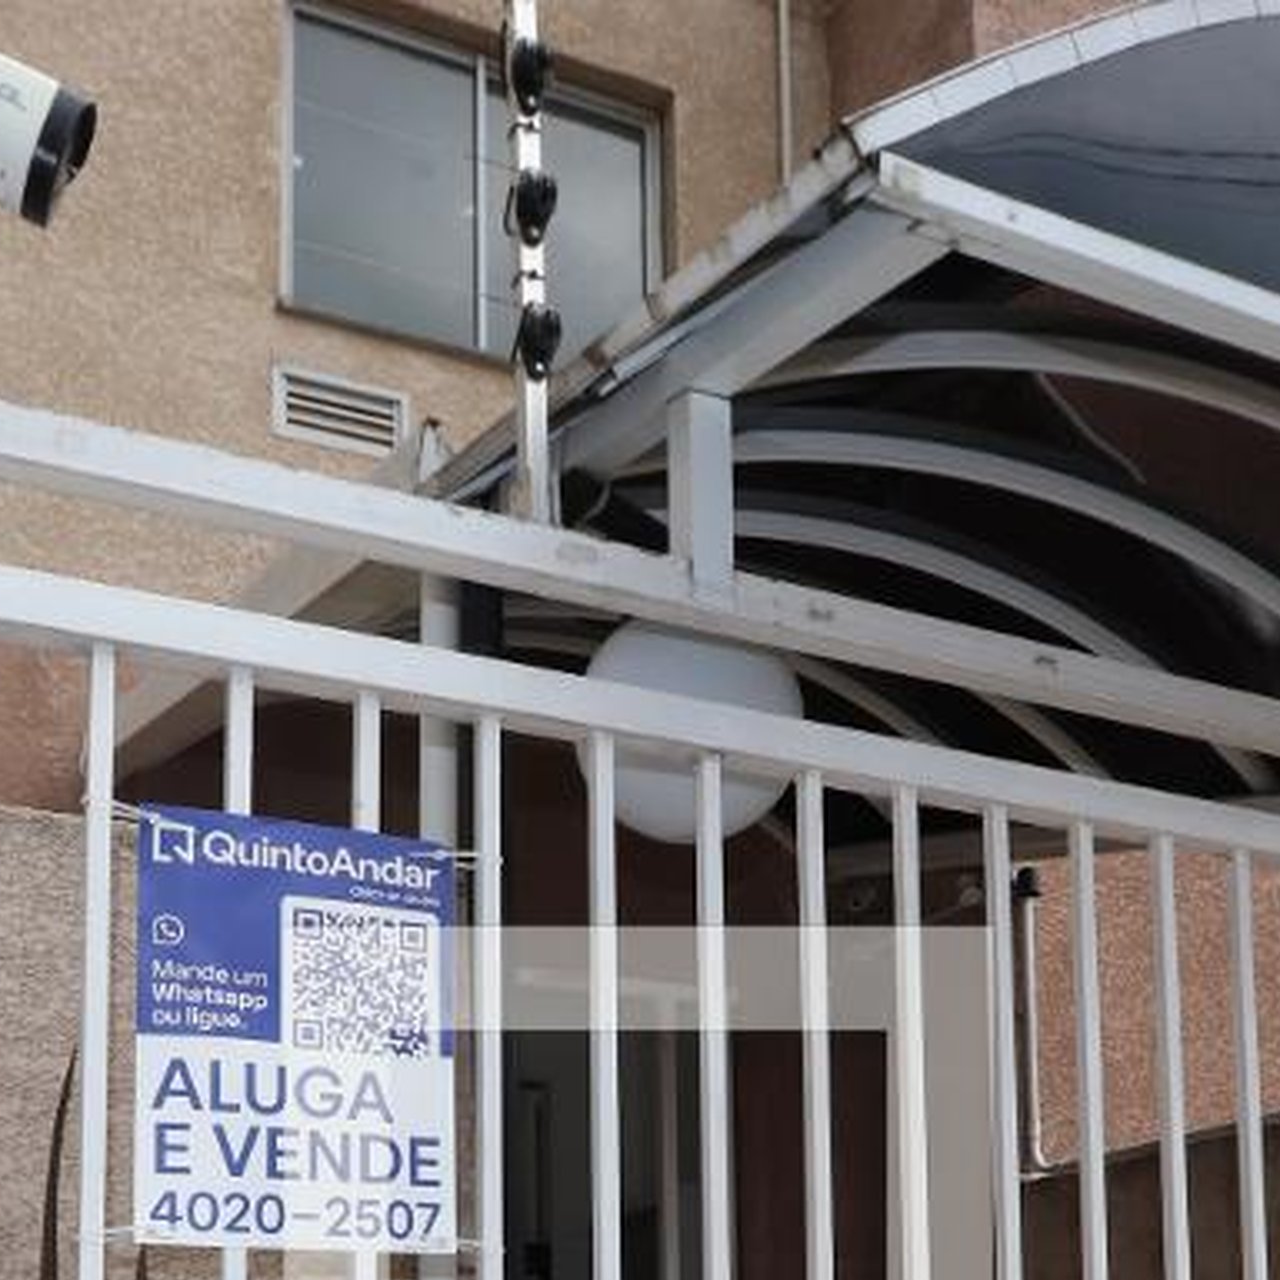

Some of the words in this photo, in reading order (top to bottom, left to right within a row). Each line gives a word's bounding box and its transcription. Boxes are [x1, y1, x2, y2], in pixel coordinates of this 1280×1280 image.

[203, 829, 441, 890] QuintoAndar
[152, 959, 230, 984] Mande
[233, 970, 268, 988] um
[152, 1058, 394, 1123] ALUGA
[153, 1122, 192, 1175] E
[213, 1124, 442, 1188] VENDE
[149, 1190, 442, 1241] 4020-2507
